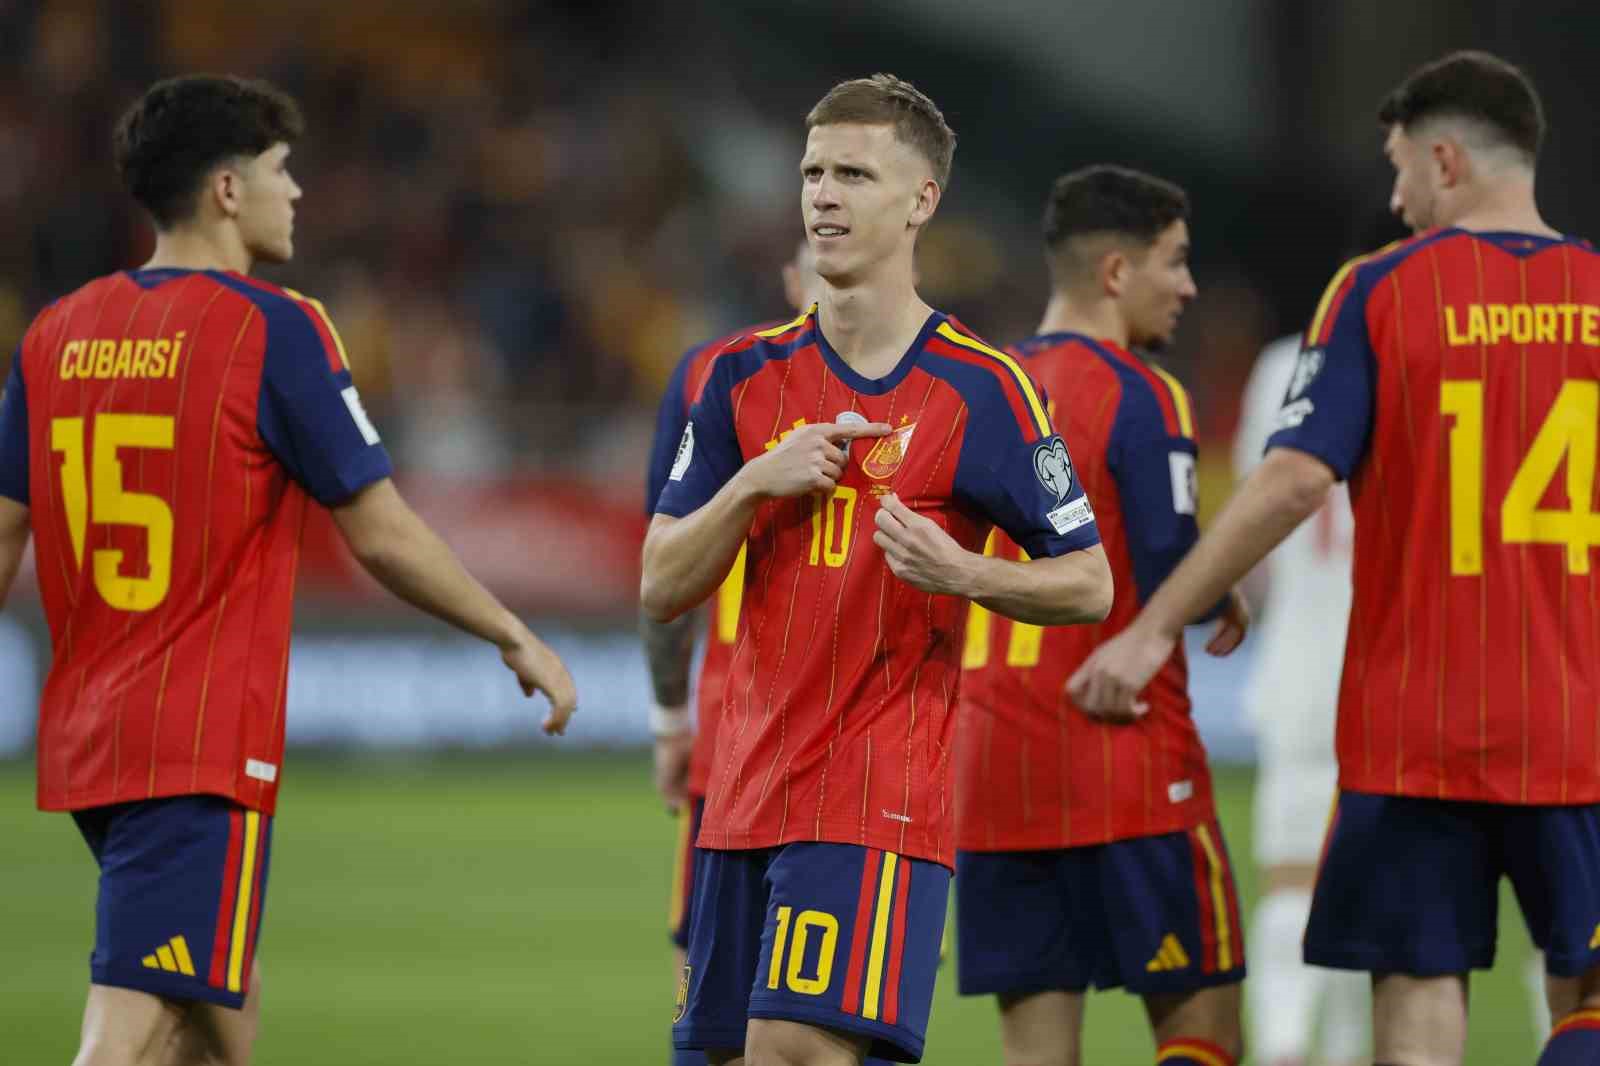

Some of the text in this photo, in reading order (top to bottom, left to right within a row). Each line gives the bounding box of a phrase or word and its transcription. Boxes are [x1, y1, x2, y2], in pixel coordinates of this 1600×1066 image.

[59, 331, 185, 380] CUBARSÍ
[1443, 303, 1600, 346] LAPORTE
[49, 411, 176, 612] 15
[1439, 379, 1600, 576] 14
[808, 485, 858, 568] 10
[767, 905, 839, 995] 10
